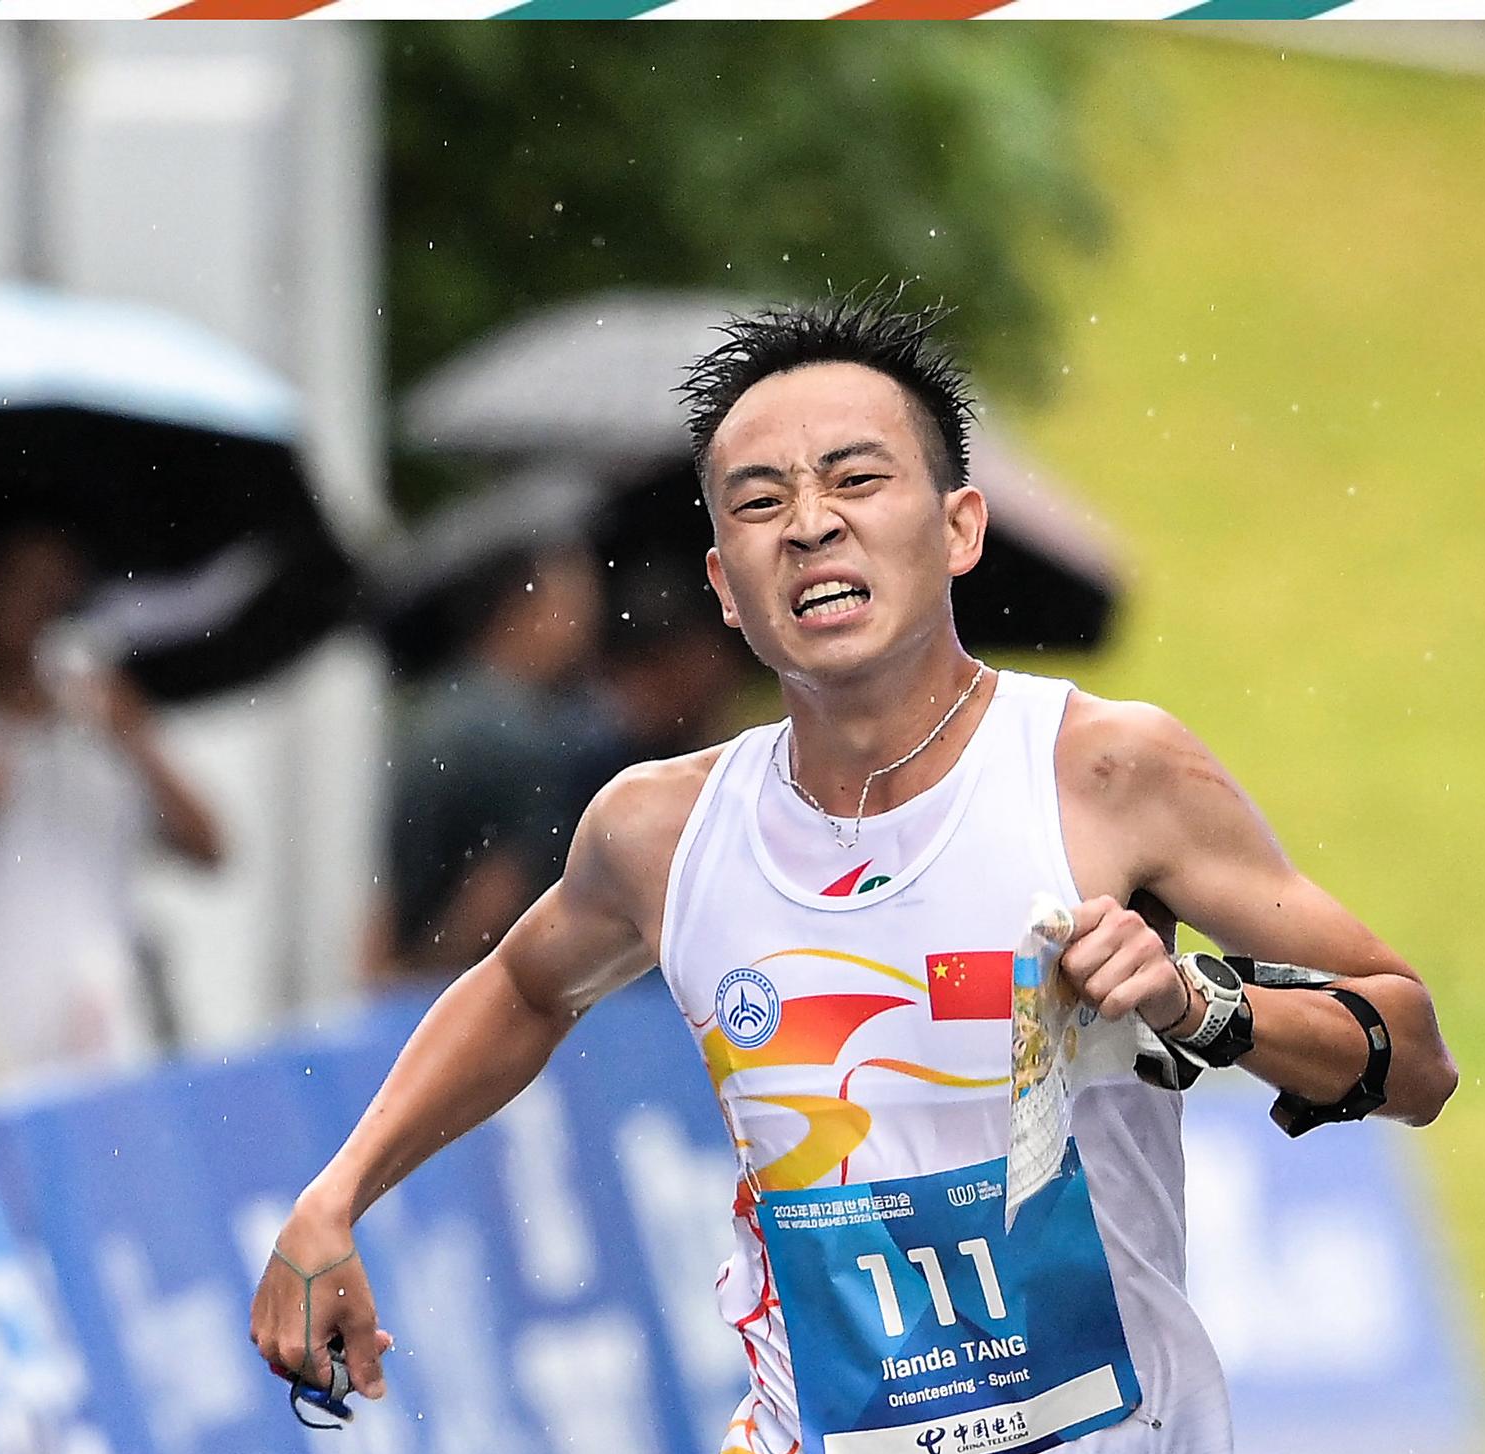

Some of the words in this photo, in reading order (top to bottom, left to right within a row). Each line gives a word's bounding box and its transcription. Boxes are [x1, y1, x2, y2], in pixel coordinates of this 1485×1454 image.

[856, 1237, 1007, 1338] 111
[881, 1346, 957, 1381] Jianda
[960, 1335, 1027, 1363] TANG
[888, 1378, 976, 1408] Orienteering
[988, 1368, 1031, 1388] Sprint
[953, 1411, 1027, 1445] 中国电信
[957, 1441, 986, 1453] CHINA
[988, 1430, 1030, 1447] TELECOM
